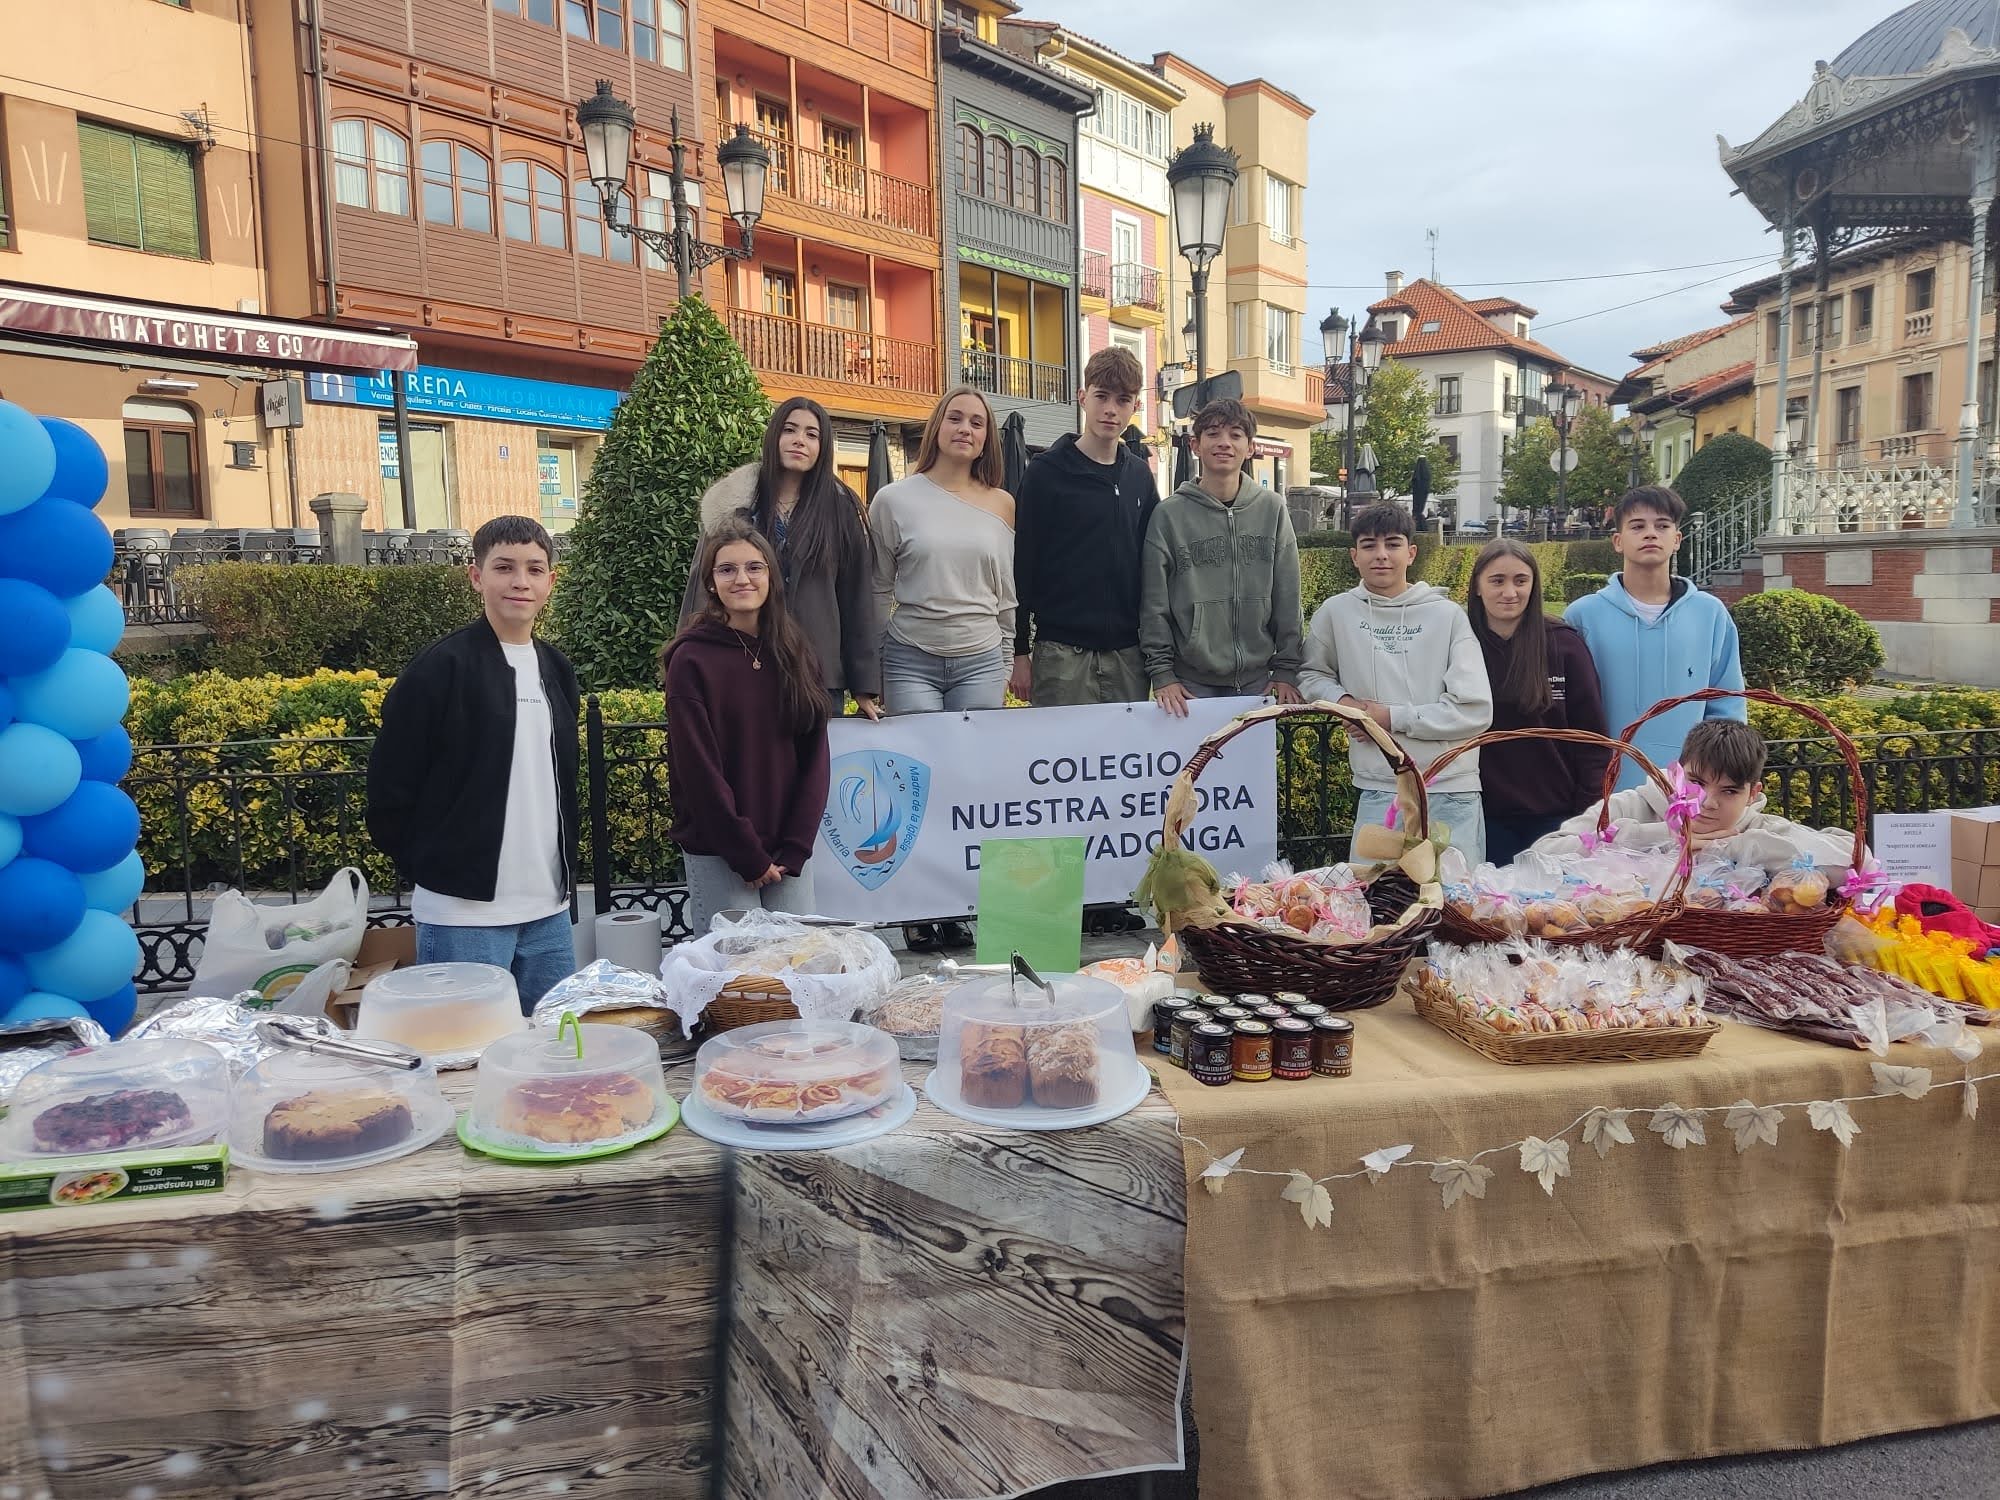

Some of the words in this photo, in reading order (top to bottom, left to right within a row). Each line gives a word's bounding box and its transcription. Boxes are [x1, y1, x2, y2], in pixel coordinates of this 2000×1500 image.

[108, 315, 247, 353] HATCHET
[256, 334, 271, 353] &
[406, 394, 432, 405] lquileres
[1360, 620, 1395, 635] Dnald
[1396, 624, 1422, 636] Duck
[1028, 751, 1182, 785] COLEGIO
[909, 766, 922, 798] Madre
[912, 799, 922, 812] de
[952, 796, 1110, 831] NUESTRA
[911, 812, 921, 823] la
[822, 811, 832, 827] de
[828, 827, 851, 858] María
[899, 823, 919, 852] Iglesia
[131, 1181, 193, 1193] transparente
[195, 1178, 216, 1187] Film
